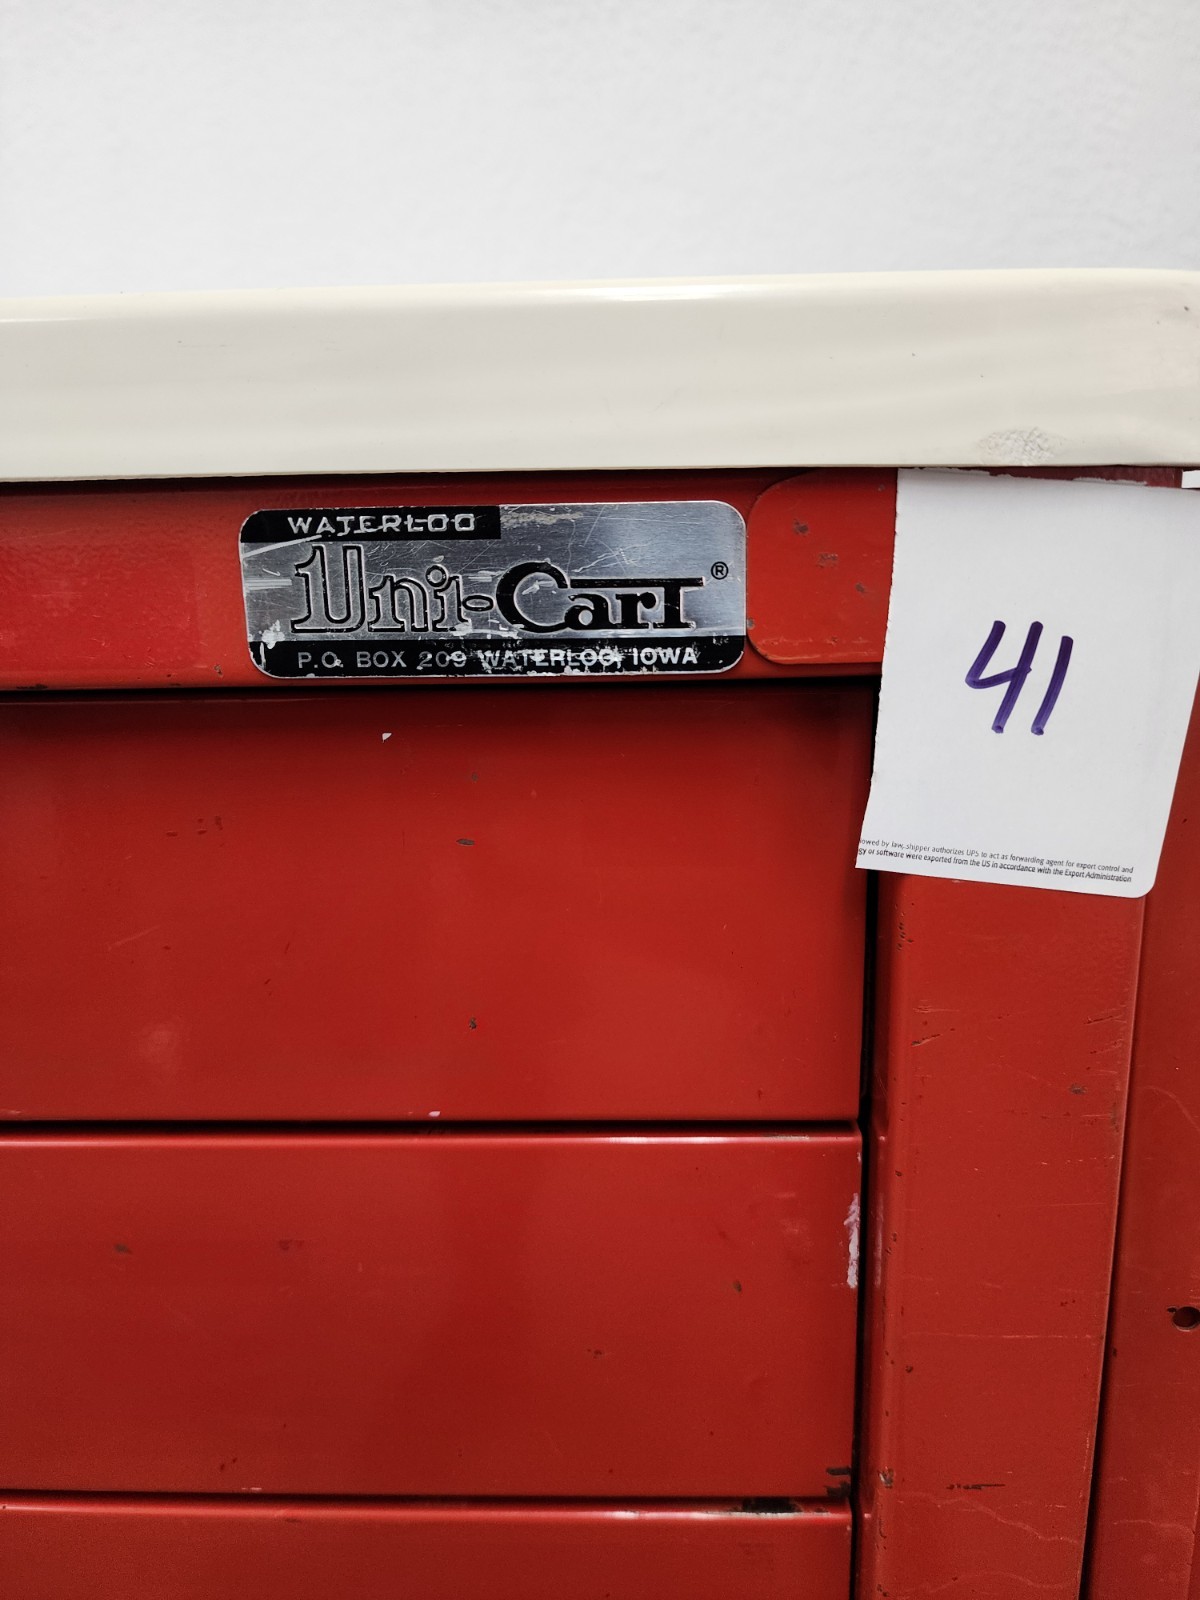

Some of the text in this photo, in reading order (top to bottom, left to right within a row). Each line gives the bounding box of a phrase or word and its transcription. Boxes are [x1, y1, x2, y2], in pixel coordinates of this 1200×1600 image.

[287, 513, 475, 537] WATERLOO
[356, 651, 407, 668] BOX
[418, 651, 467, 670] 209
[632, 647, 698, 666] IOWA
[965, 620, 1074, 736] 41
[876, 850, 905, 858] software
[924, 854, 952, 863] exported
[953, 857, 969, 865] from
[969, 858, 981, 867] the
[981, 860, 991, 868] US
[999, 862, 1036, 873] accordance
[1037, 866, 1052, 875] with
[1053, 867, 1064, 876] the
[1064, 868, 1085, 878] Export
[1085, 871, 1132, 882] Administration
[881, 841, 890, 849] by
[906, 843, 930, 852] shipper
[931, 846, 964, 855] authorizes
[966, 849, 979, 857] UPS
[1010, 853, 1044, 865] forwarding
[1045, 859, 1064, 867] agent
[1076, 862, 1097, 870] export
[1097, 864, 1121, 872] control
[1121, 866, 1134, 874] and
